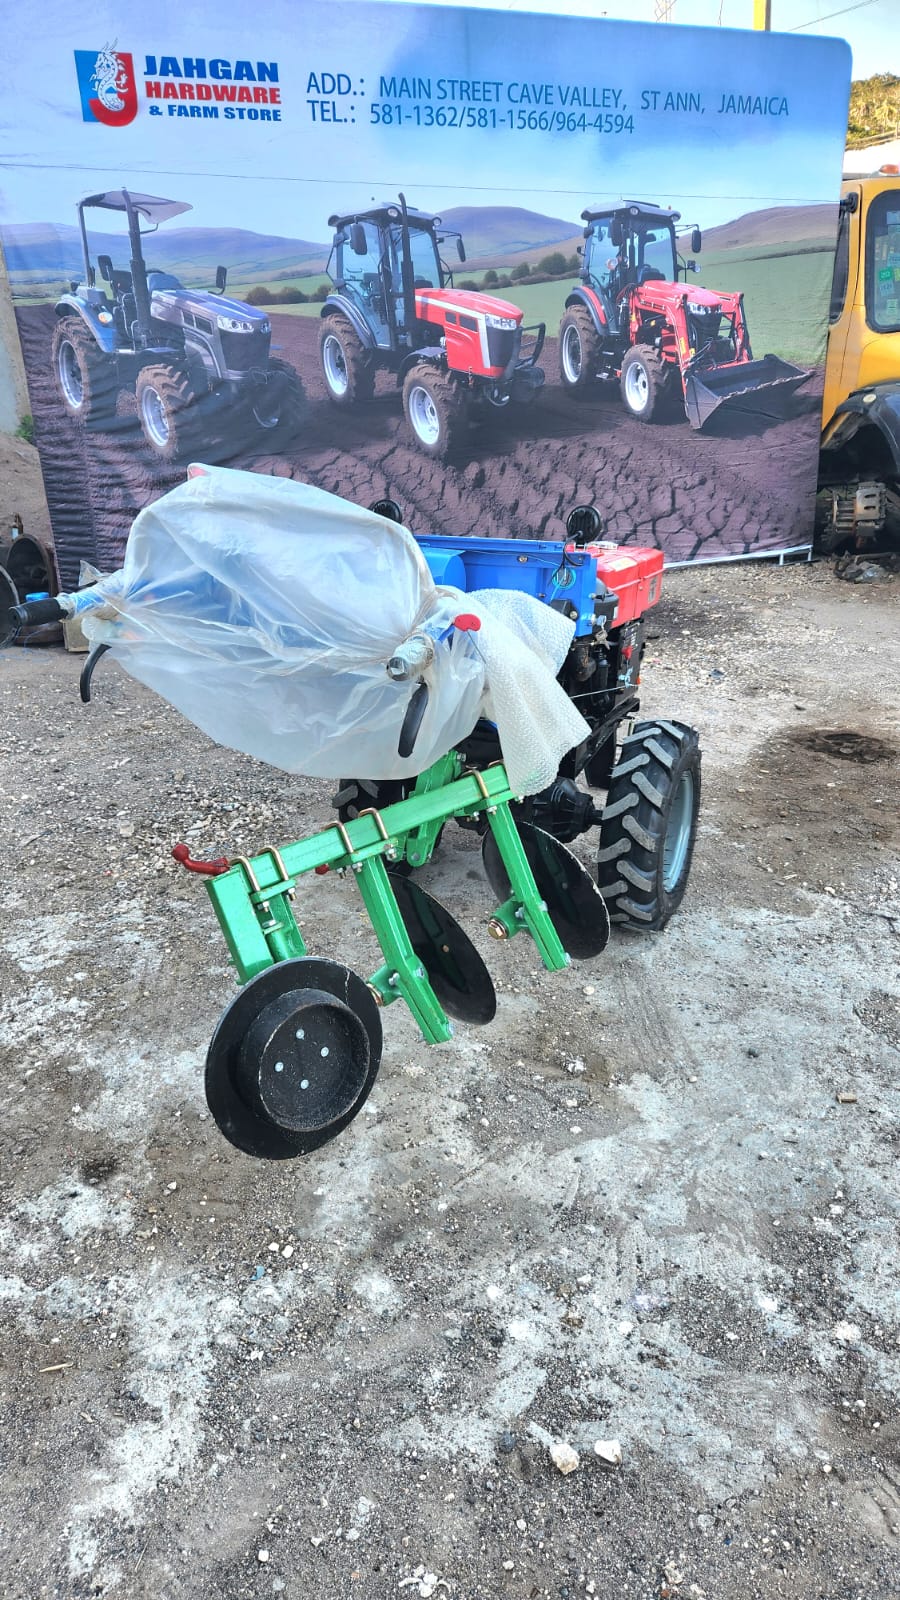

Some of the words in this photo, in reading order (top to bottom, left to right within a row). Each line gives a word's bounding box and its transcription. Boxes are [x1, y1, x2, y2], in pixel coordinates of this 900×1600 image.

[143, 55, 279, 82] JAHGAN
[145, 81, 282, 104] HARDWARE
[306, 72, 365, 97] ADD.:
[379, 76, 432, 100] MAIN
[436, 79, 503, 102] STREET
[507, 83, 554, 105] CAVE
[558, 85, 627, 111] VALLEY,
[641, 90, 661, 110] ST
[663, 92, 705, 114] ANN,
[717, 94, 789, 116] JAMAICA
[148, 105, 163, 117] &
[168, 105, 219, 119] FARM
[224, 106, 282, 122] STORE
[307, 100, 356, 123] TEL.:
[370, 103, 634, 134] 581-1362/581-1566/964-4594
